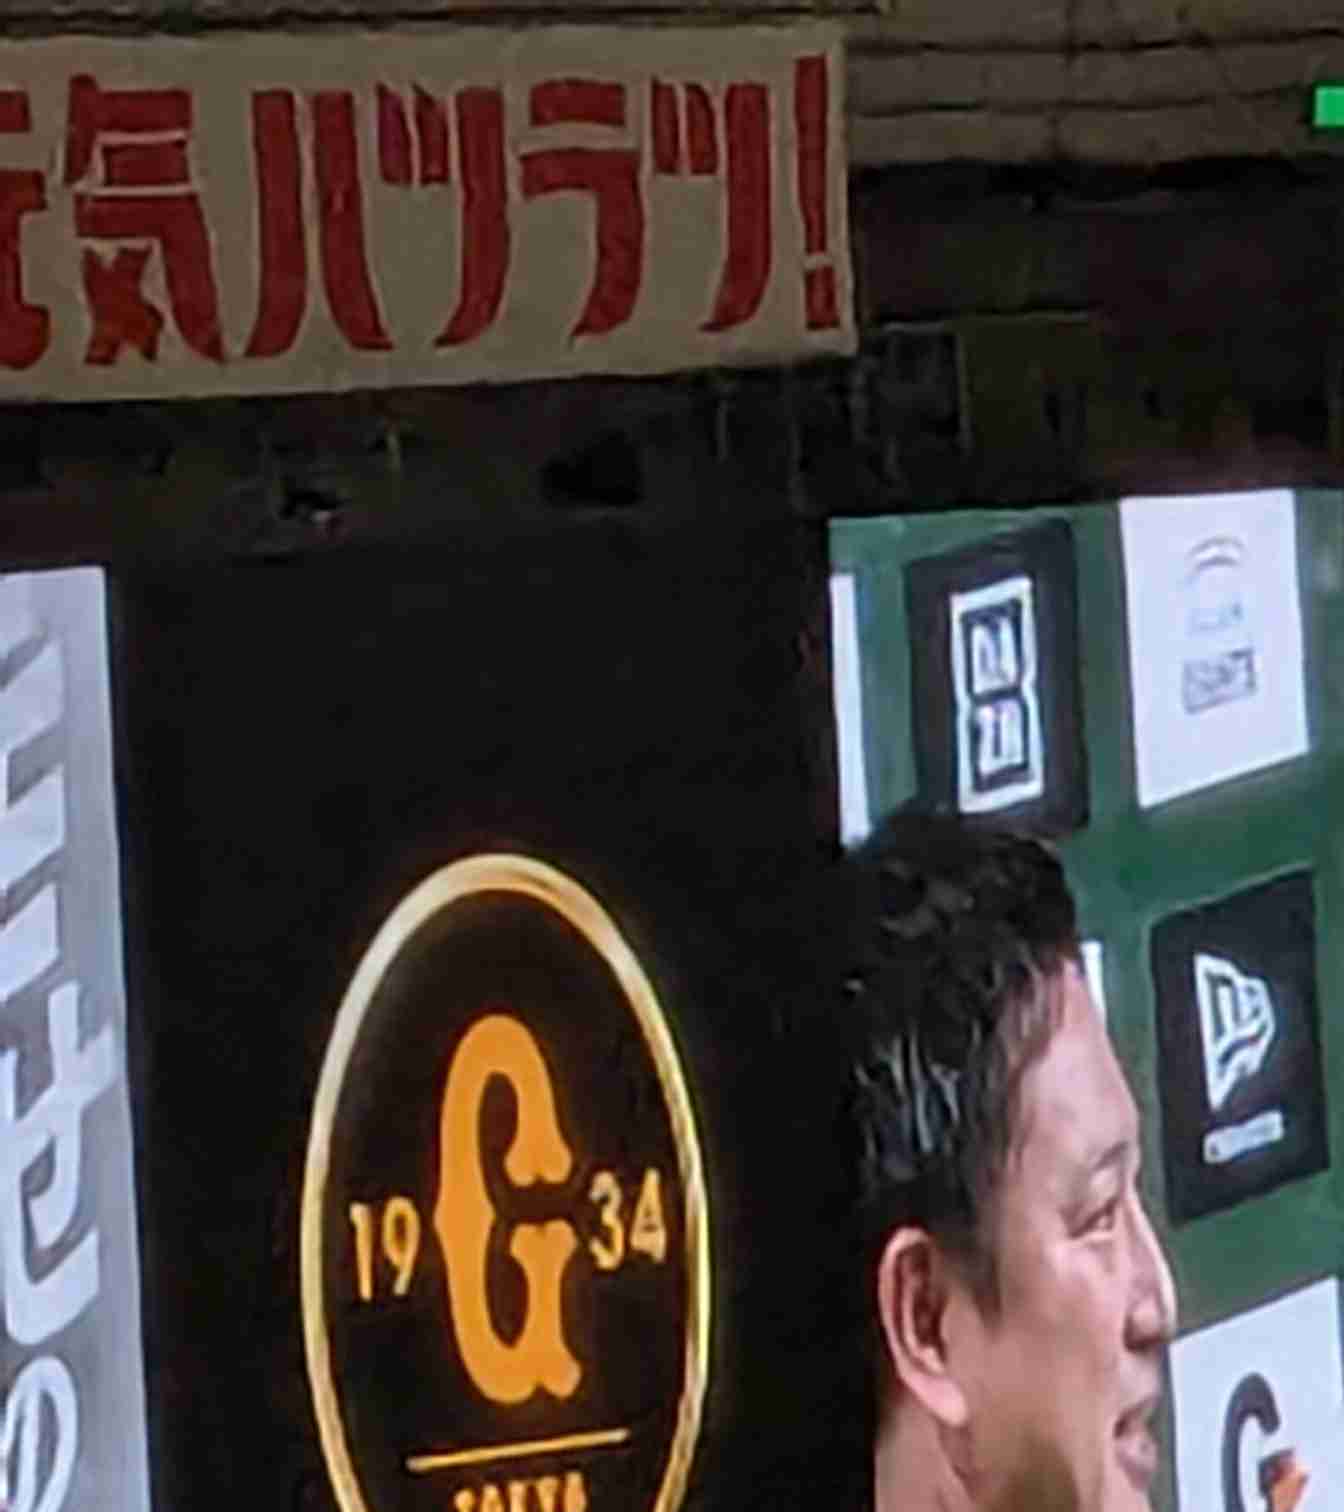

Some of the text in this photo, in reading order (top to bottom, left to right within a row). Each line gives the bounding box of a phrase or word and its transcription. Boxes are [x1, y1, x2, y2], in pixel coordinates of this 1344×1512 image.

[350, 1015, 668, 1404] 19 G 34
